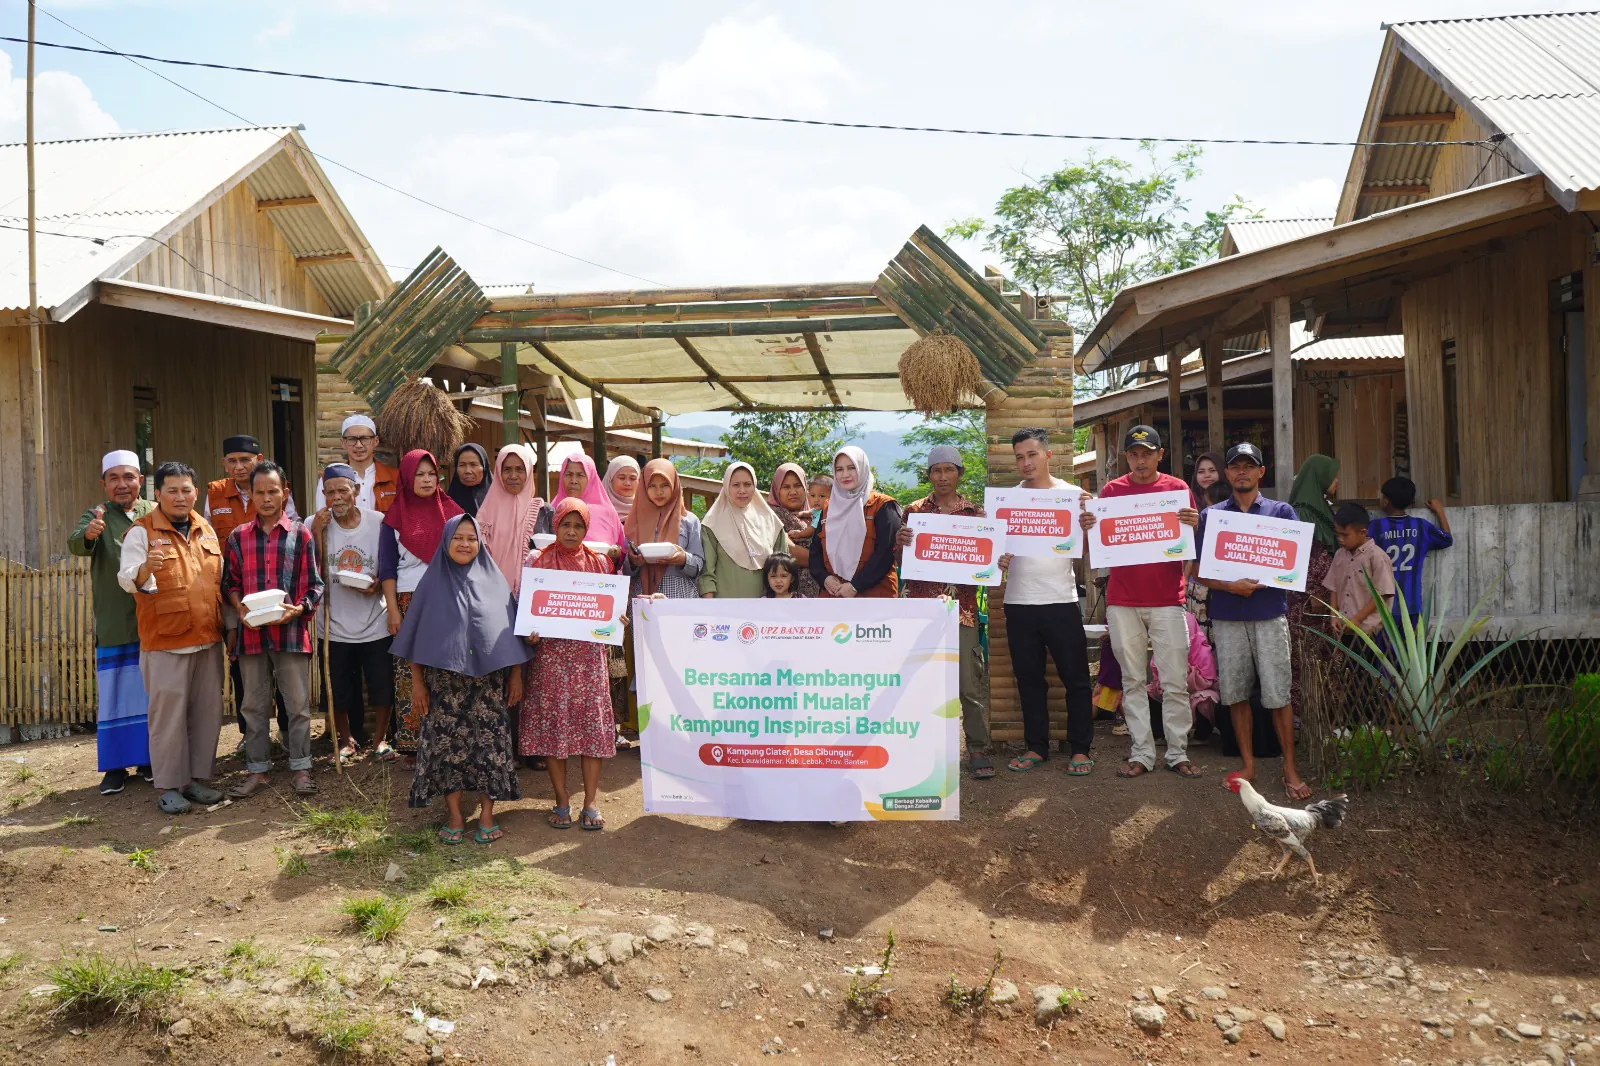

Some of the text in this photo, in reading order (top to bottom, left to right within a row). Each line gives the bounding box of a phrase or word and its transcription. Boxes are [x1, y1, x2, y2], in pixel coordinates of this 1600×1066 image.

[1115, 516, 1162, 526] PENYERAHAN
[1022, 525, 1047, 534] BANK
[1049, 526, 1064, 534] DKI
[1115, 525, 1149, 533] BANTUAN
[1385, 529, 1418, 540] MILITO
[932, 536, 976, 545] PENYERAHAN
[1108, 529, 1173, 543] UPZ BANK DKI
[1236, 535, 1279, 548] BANTUAN
[922, 550, 984, 562] UPZ BANK DKI
[1224, 542, 1287, 558] MODAL USAHA
[1224, 552, 1284, 567] JUAL PAPEDA
[1386, 544, 1415, 571] 22
[549, 593, 597, 602] PENYERAHAN
[547, 600, 580, 608] BANTUAN
[538, 607, 605, 618] UPZ BANK DKI
[856, 623, 891, 638] bmh
[684, 668, 900, 690] Bersama Membangun
[713, 692, 870, 710] Ekonomi Mualaf
[670, 715, 920, 738] Kampung Inspirasi Baduy
[726, 747, 854, 757] Kampung Ciater, Desa Cibungur,
